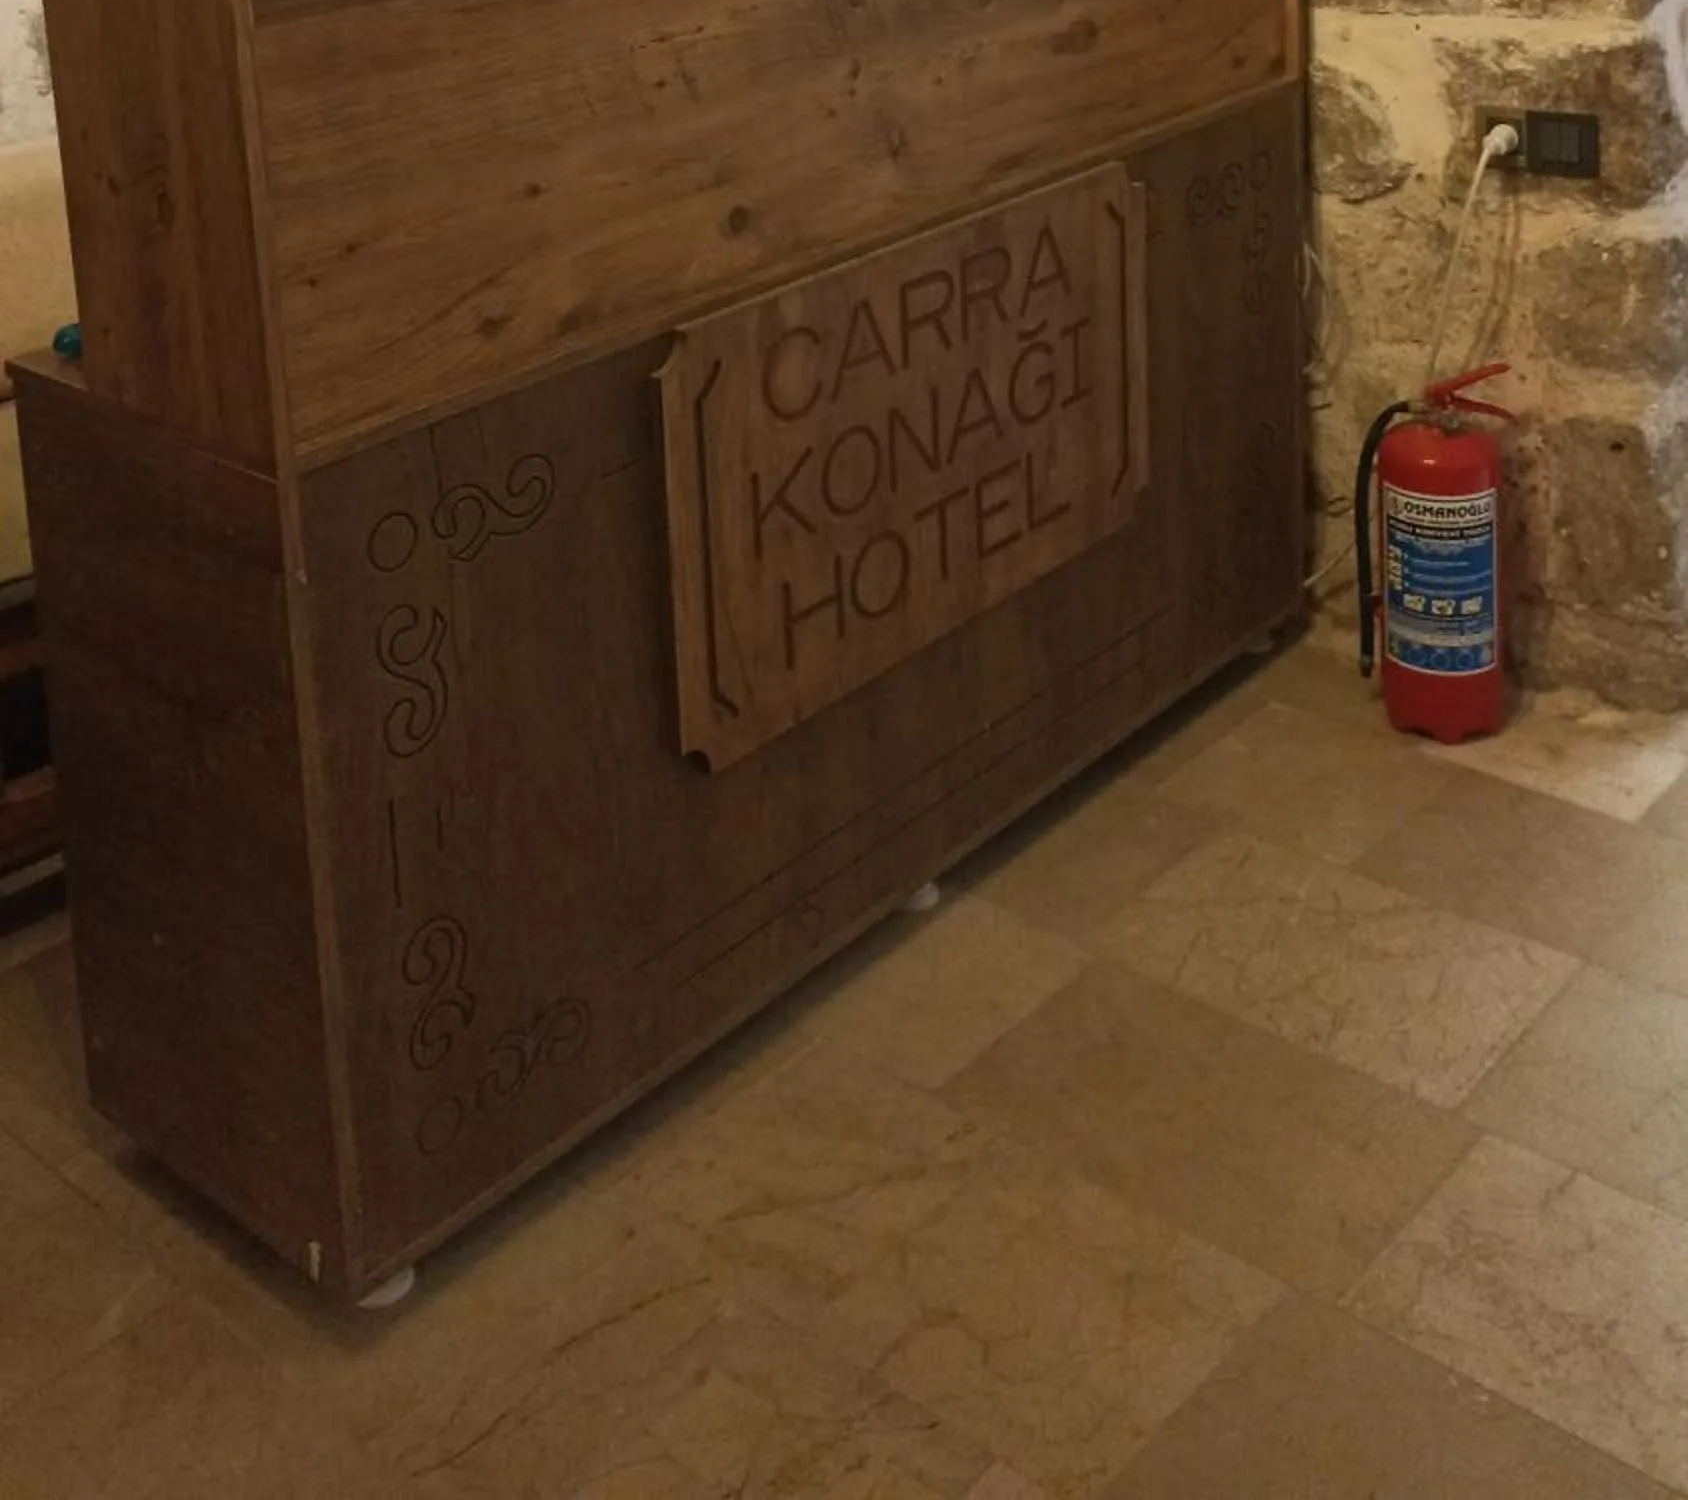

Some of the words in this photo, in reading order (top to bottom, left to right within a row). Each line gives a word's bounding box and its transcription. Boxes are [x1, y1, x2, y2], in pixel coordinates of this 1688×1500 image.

[761, 224, 1072, 421] CARRA
[751, 317, 1095, 562] KONAĞI
[782, 451, 1071, 670] HOTEL
